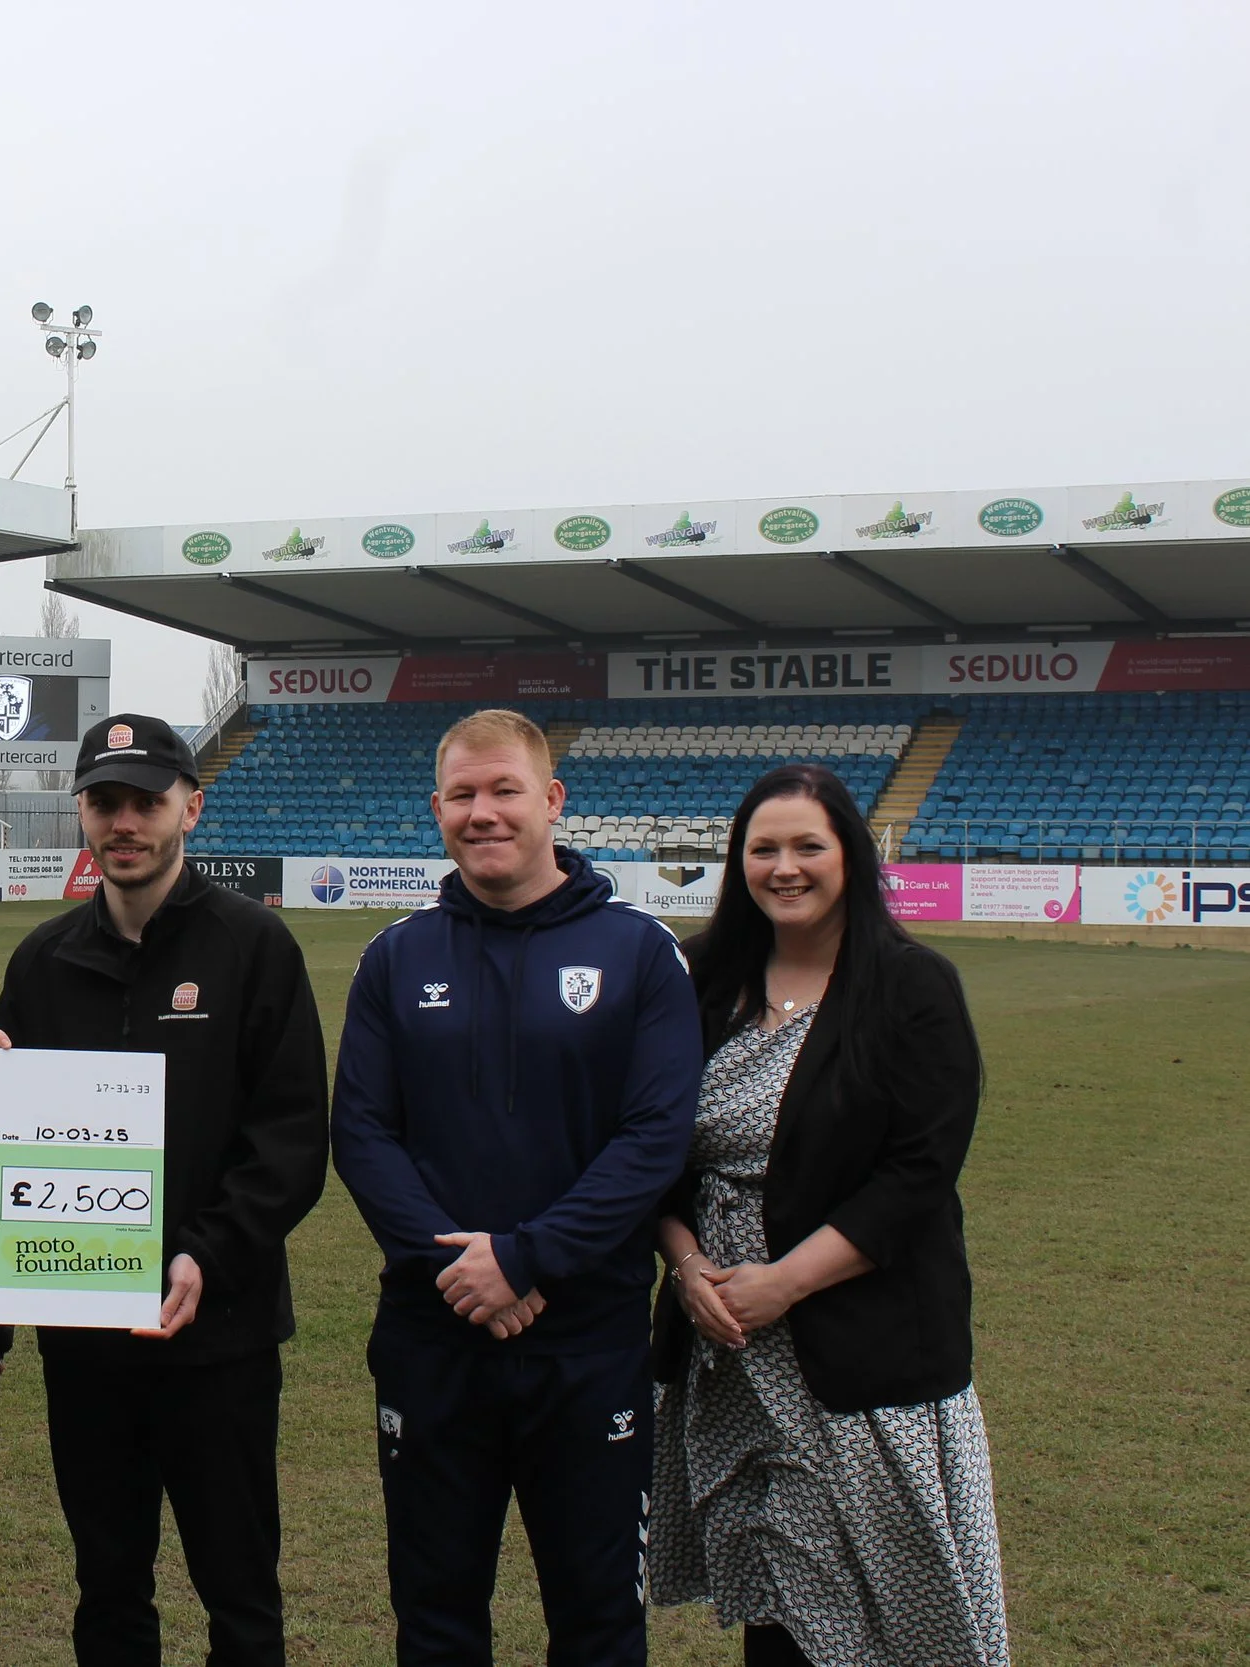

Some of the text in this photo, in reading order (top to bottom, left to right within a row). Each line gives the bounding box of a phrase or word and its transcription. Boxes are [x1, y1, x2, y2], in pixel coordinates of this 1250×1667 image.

[985, 500, 1035, 514] Wentvalley
[766, 509, 811, 522] Wentvalley
[984, 514, 1030, 522] Aggregates
[1082, 502, 1165, 530] wentvalley
[561, 517, 603, 531] Wentvalley
[764, 522, 807, 530] Aggregates
[856, 511, 933, 537] wentvalley
[983, 521, 1037, 535] Recycling Ltd
[187, 533, 225, 546] Wentvalley
[367, 526, 408, 539] Wentvalley
[645, 520, 717, 547] wentvalley
[764, 528, 814, 542] Recycling Ltd
[262, 536, 325, 560] wentvalley
[447, 529, 515, 553] wentvalley
[558, 536, 606, 549] Recycling Ltd
[186, 551, 228, 564] Recycling Ltd
[366, 544, 410, 557] Recycling Ltd
[636, 653, 891, 691] THE STABLE
[949, 653, 1078, 683] SEDULO
[269, 668, 372, 694] SEDULO
[518, 686, 571, 694] sedulo.co.uk
[196, 862, 256, 877] DLEYS
[350, 867, 425, 877] NORTHERN
[910, 881, 950, 889] Care Link
[645, 892, 717, 909] Lagentium
[1182, 871, 1250, 923] ips
[174, 996, 196, 1004] KING
[419, 999, 450, 1008] hummel
[96, 1083, 150, 1094] 17-31-33
[36, 1127, 129, 1142] 10-03-25
[16, 1237, 75, 1253] moto
[16, 1253, 143, 1273] foundation
[608, 1427, 635, 1441] hummel
